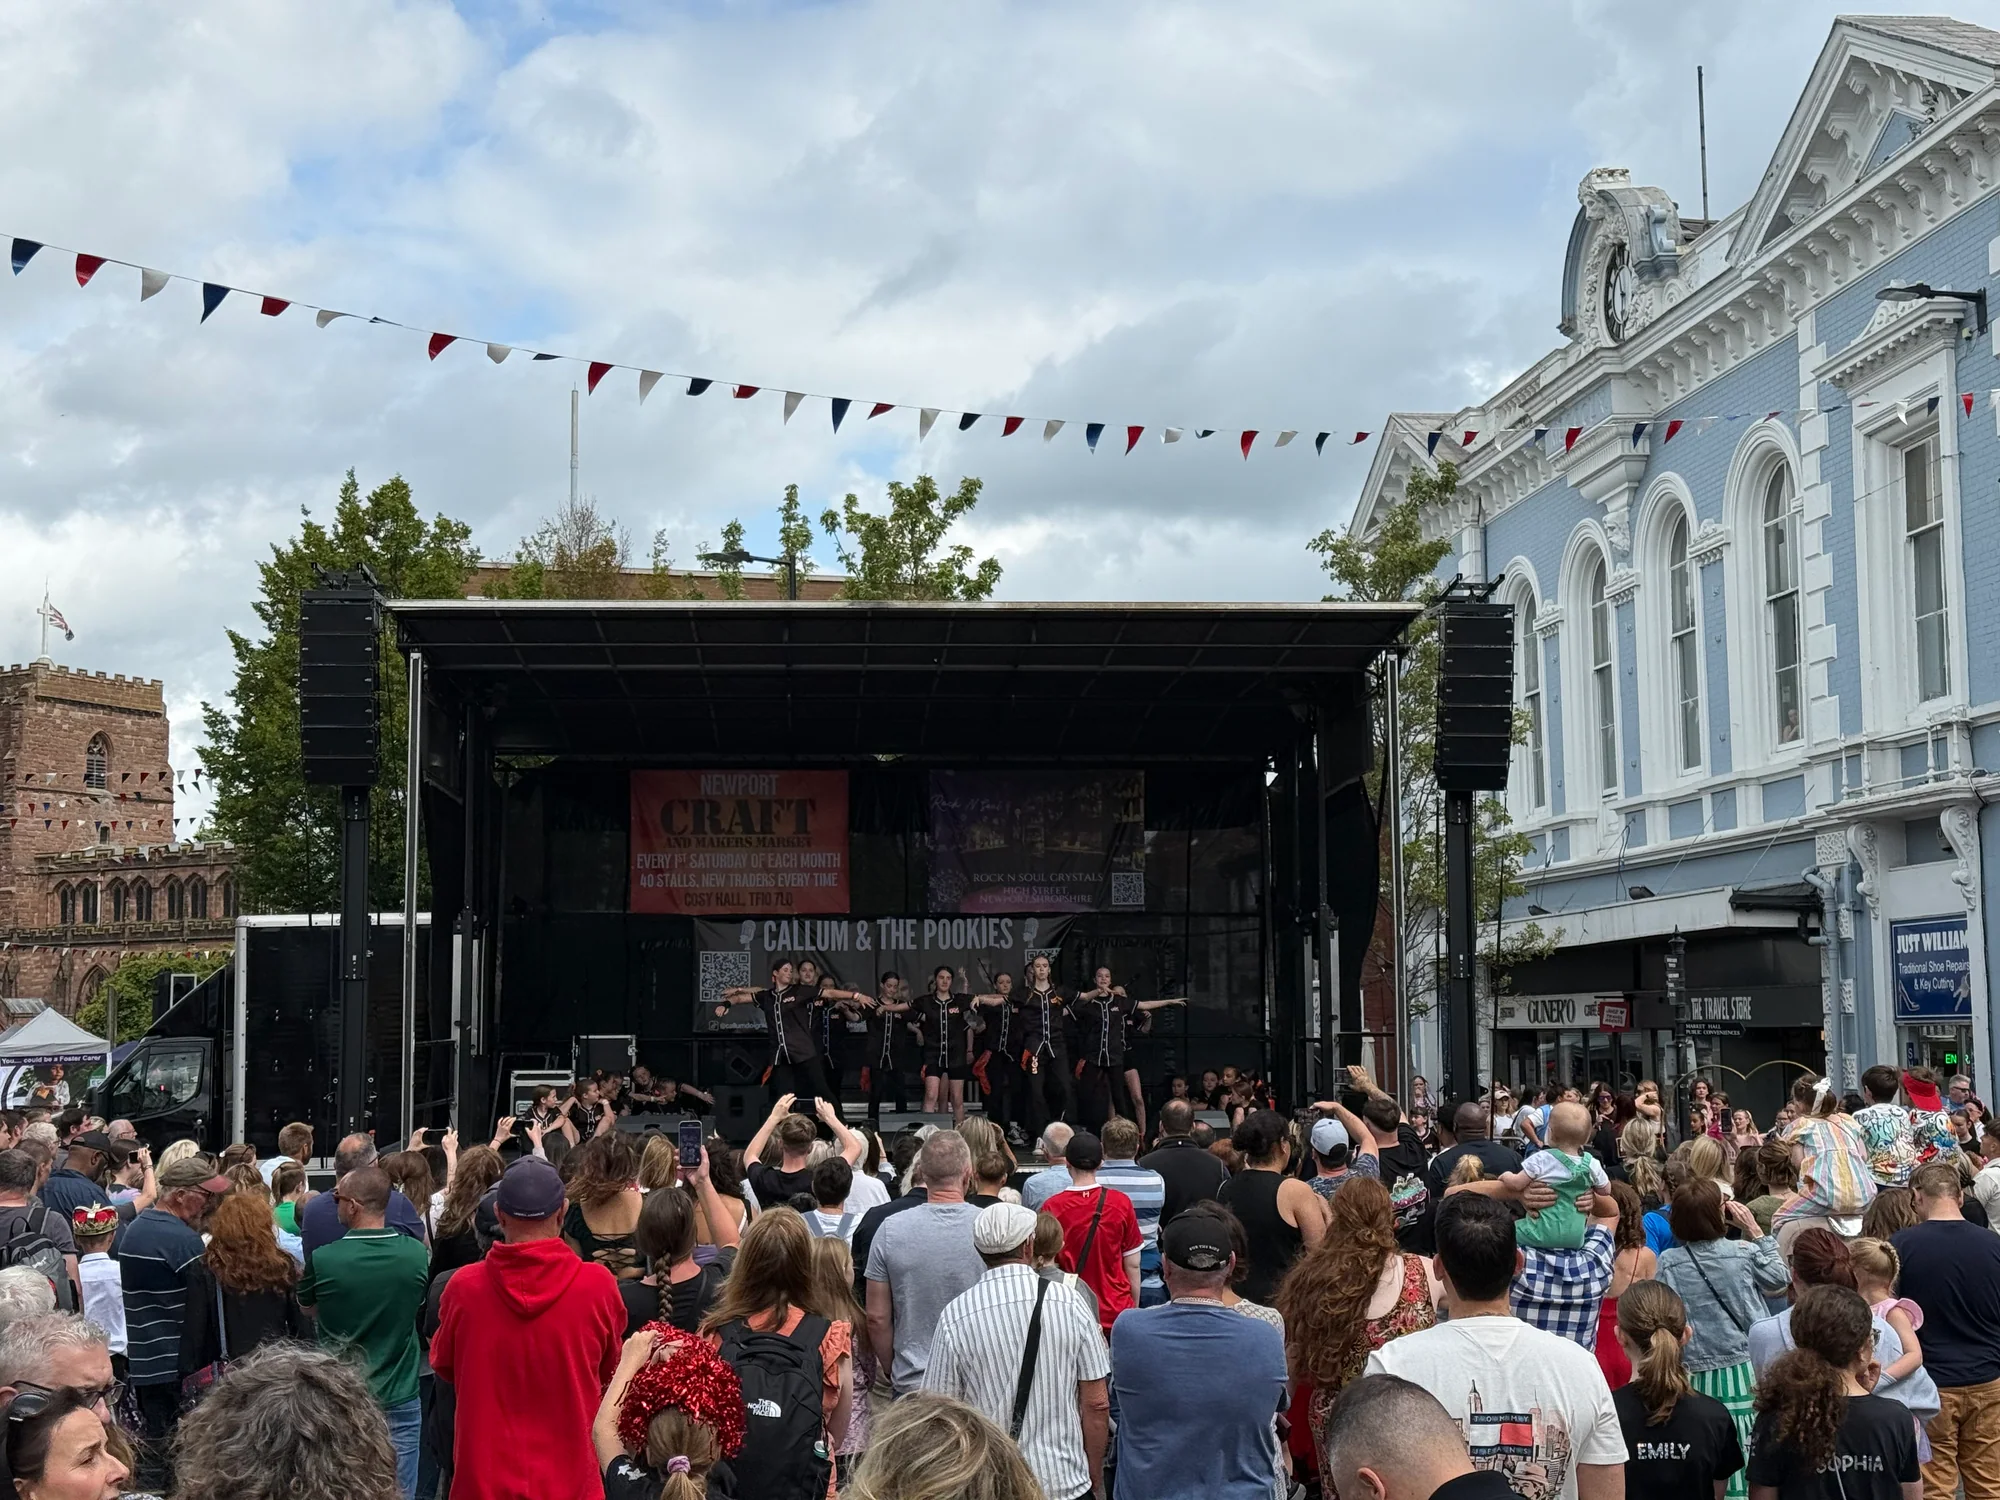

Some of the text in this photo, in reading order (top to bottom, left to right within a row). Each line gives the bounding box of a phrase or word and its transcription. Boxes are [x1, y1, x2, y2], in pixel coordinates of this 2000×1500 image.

[700, 774, 779, 796] NEWPORT
[660, 799, 816, 836] CRAFT
[664, 837, 813, 849] AND MAKERS MARKET
[637, 853, 672, 869] EVERY
[690, 853, 748, 869] SATURDAY
[751, 853, 767, 869] OF
[768, 853, 798, 869] EACH
[800, 853, 841, 869] MONTH
[639, 873, 654, 888] 40
[702, 873, 726, 888] NEW
[729, 873, 776, 888] TRADERS
[778, 873, 810, 888] EVERY
[813, 873, 838, 888] TIME
[973, 873, 1104, 882] ROCK N SOUL CRYSTALS
[1003, 886, 1030, 895] HIGH
[684, 892, 712, 907] COSY
[763, 918, 1014, 952] CALLUM & THE POOKIES
[1897, 933, 1920, 954] JUST
[1898, 959, 1970, 974] Traditional Shoe Repairs
[1913, 977, 1954, 992] & Key Cutting
[1690, 997, 1752, 1021] THE TRAVEL STORE
[1637, 1442, 1691, 1460] EMILY
